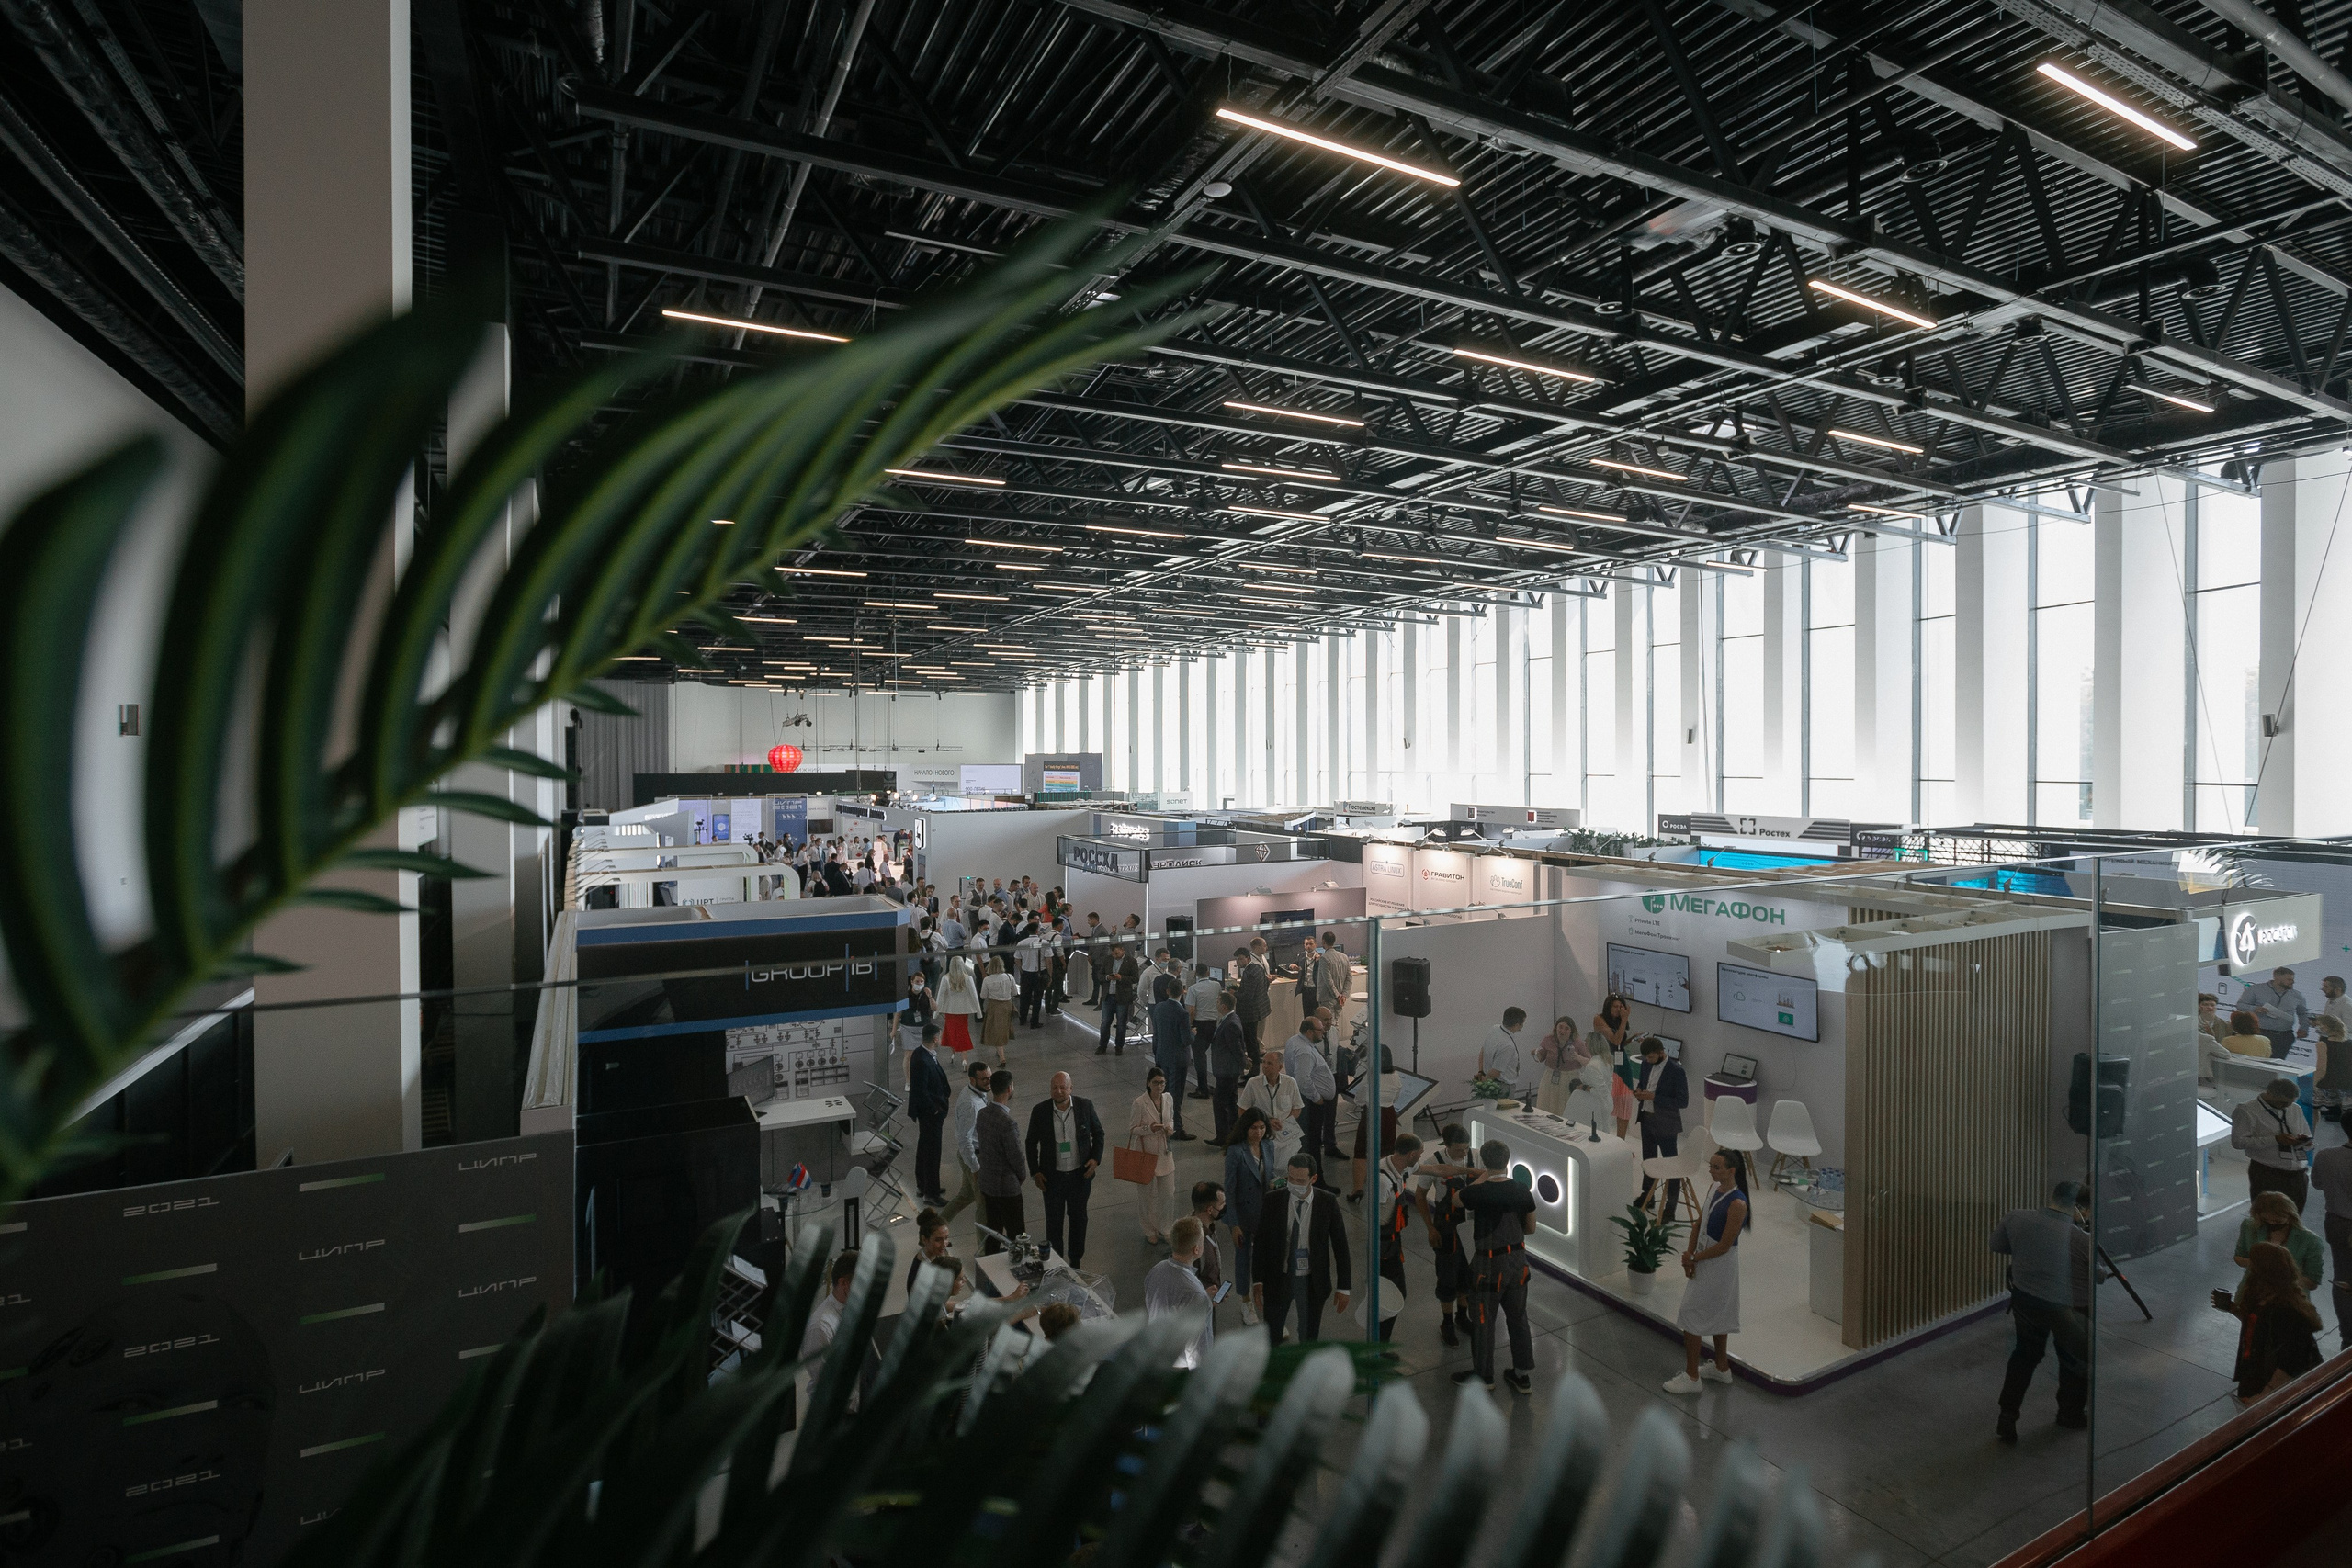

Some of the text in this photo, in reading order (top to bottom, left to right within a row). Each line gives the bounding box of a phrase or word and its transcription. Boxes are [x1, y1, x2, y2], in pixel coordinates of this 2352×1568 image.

[1348, 803, 1376, 811] Ростелеком
[1758, 829, 1791, 839] Ростех
[1073, 846, 1119, 873] РОССХД
[1372, 863, 1387, 872] ASTRA
[1430, 871, 1465, 881] ГРАВИТОН
[1501, 876, 1523, 890] TrueConf
[1634, 917, 1653, 926] Private
[1634, 929, 1657, 938] МегаФон
[123, 1196, 220, 1217] 2021
[123, 1333, 220, 1358] 2021
[125, 1469, 221, 1497] 2021
